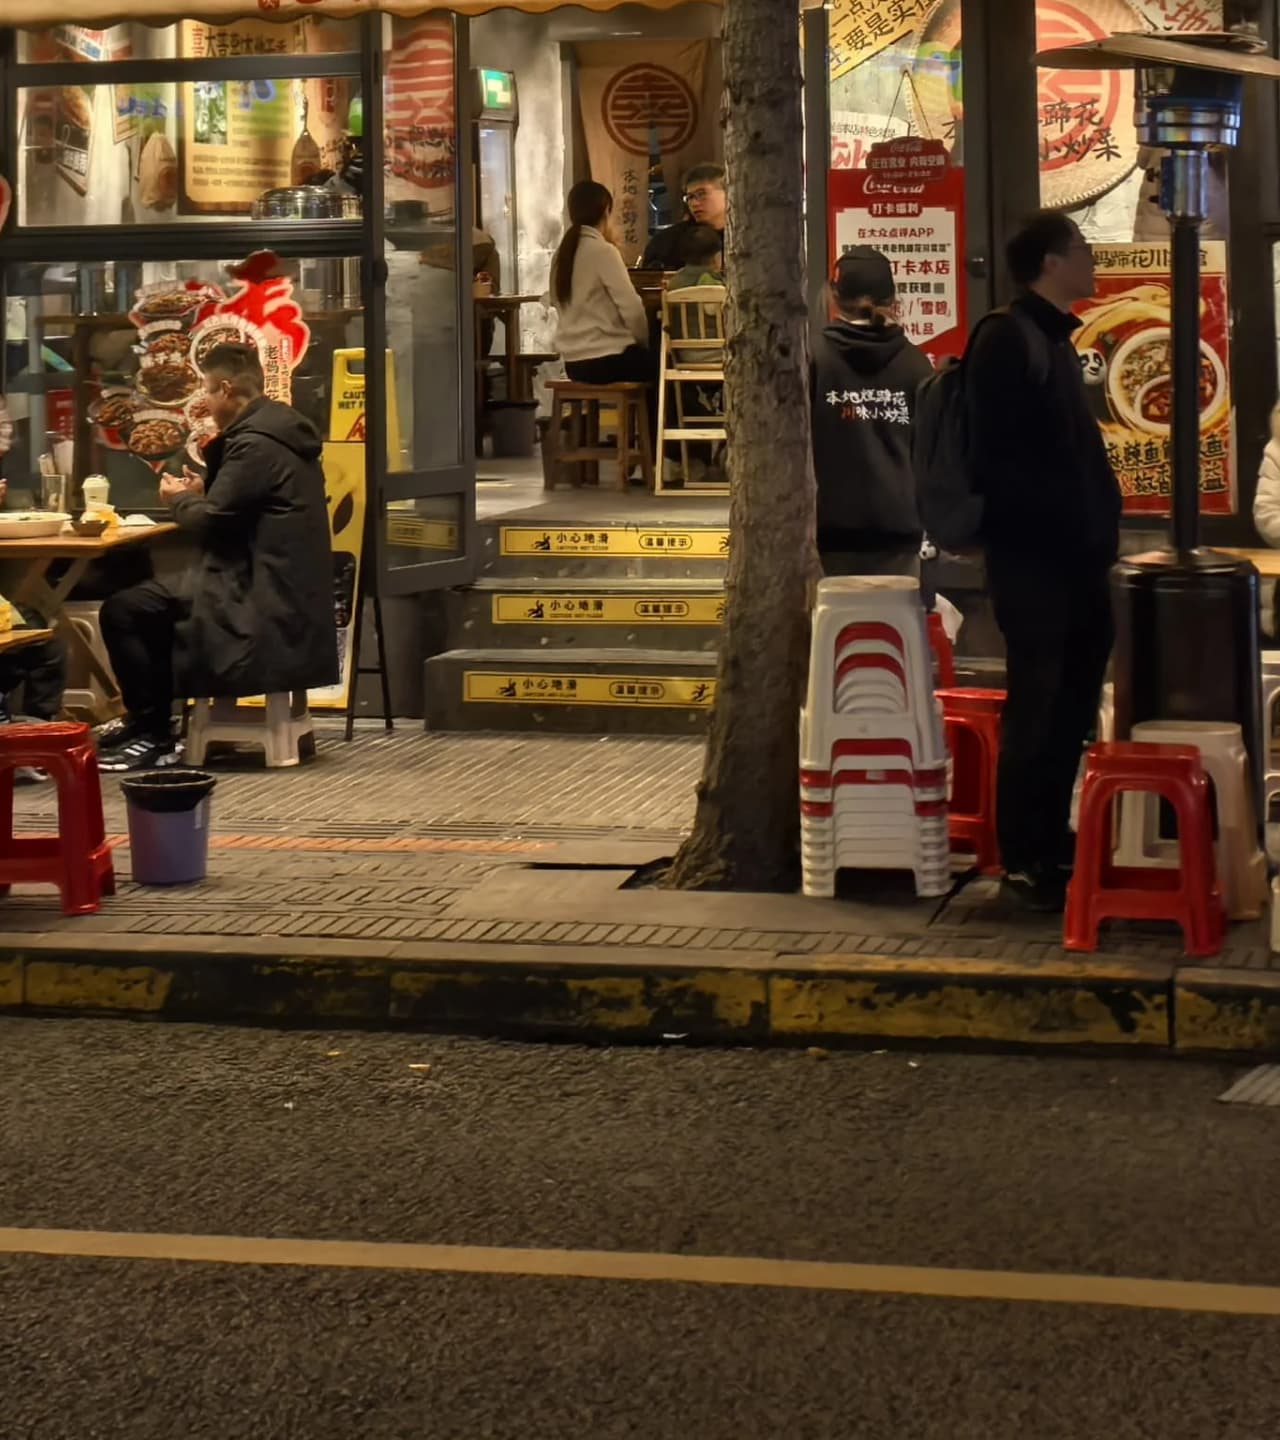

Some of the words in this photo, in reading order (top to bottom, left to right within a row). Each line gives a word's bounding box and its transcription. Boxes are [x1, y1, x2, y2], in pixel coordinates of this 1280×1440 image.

[872, 202, 919, 215] 打卡福利
[857, 227, 935, 239] 在大众点评APP
